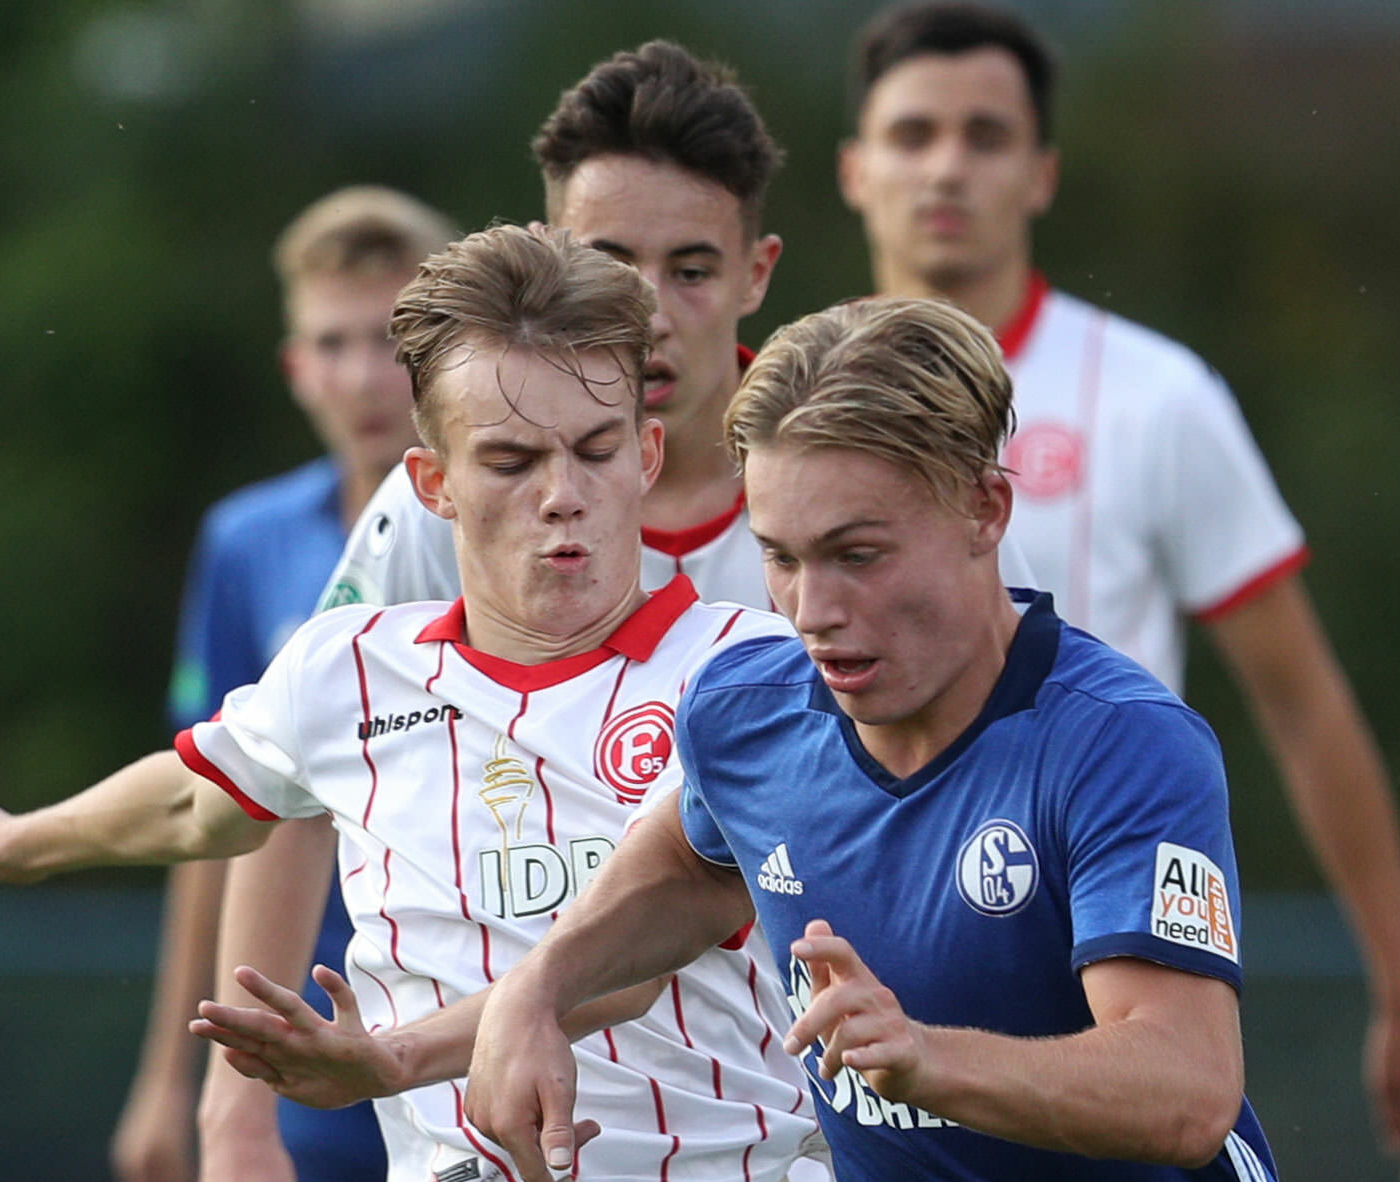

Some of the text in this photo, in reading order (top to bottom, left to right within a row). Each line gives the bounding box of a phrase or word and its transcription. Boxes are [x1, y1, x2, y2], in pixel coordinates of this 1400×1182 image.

[640, 756, 665, 774] 95
[757, 873, 804, 895] adidas
[983, 875, 1009, 905] 04
[1160, 857, 1207, 901] All
[1159, 890, 1208, 920] you
[1209, 875, 1231, 948] Fresh
[1155, 918, 1209, 946] need
